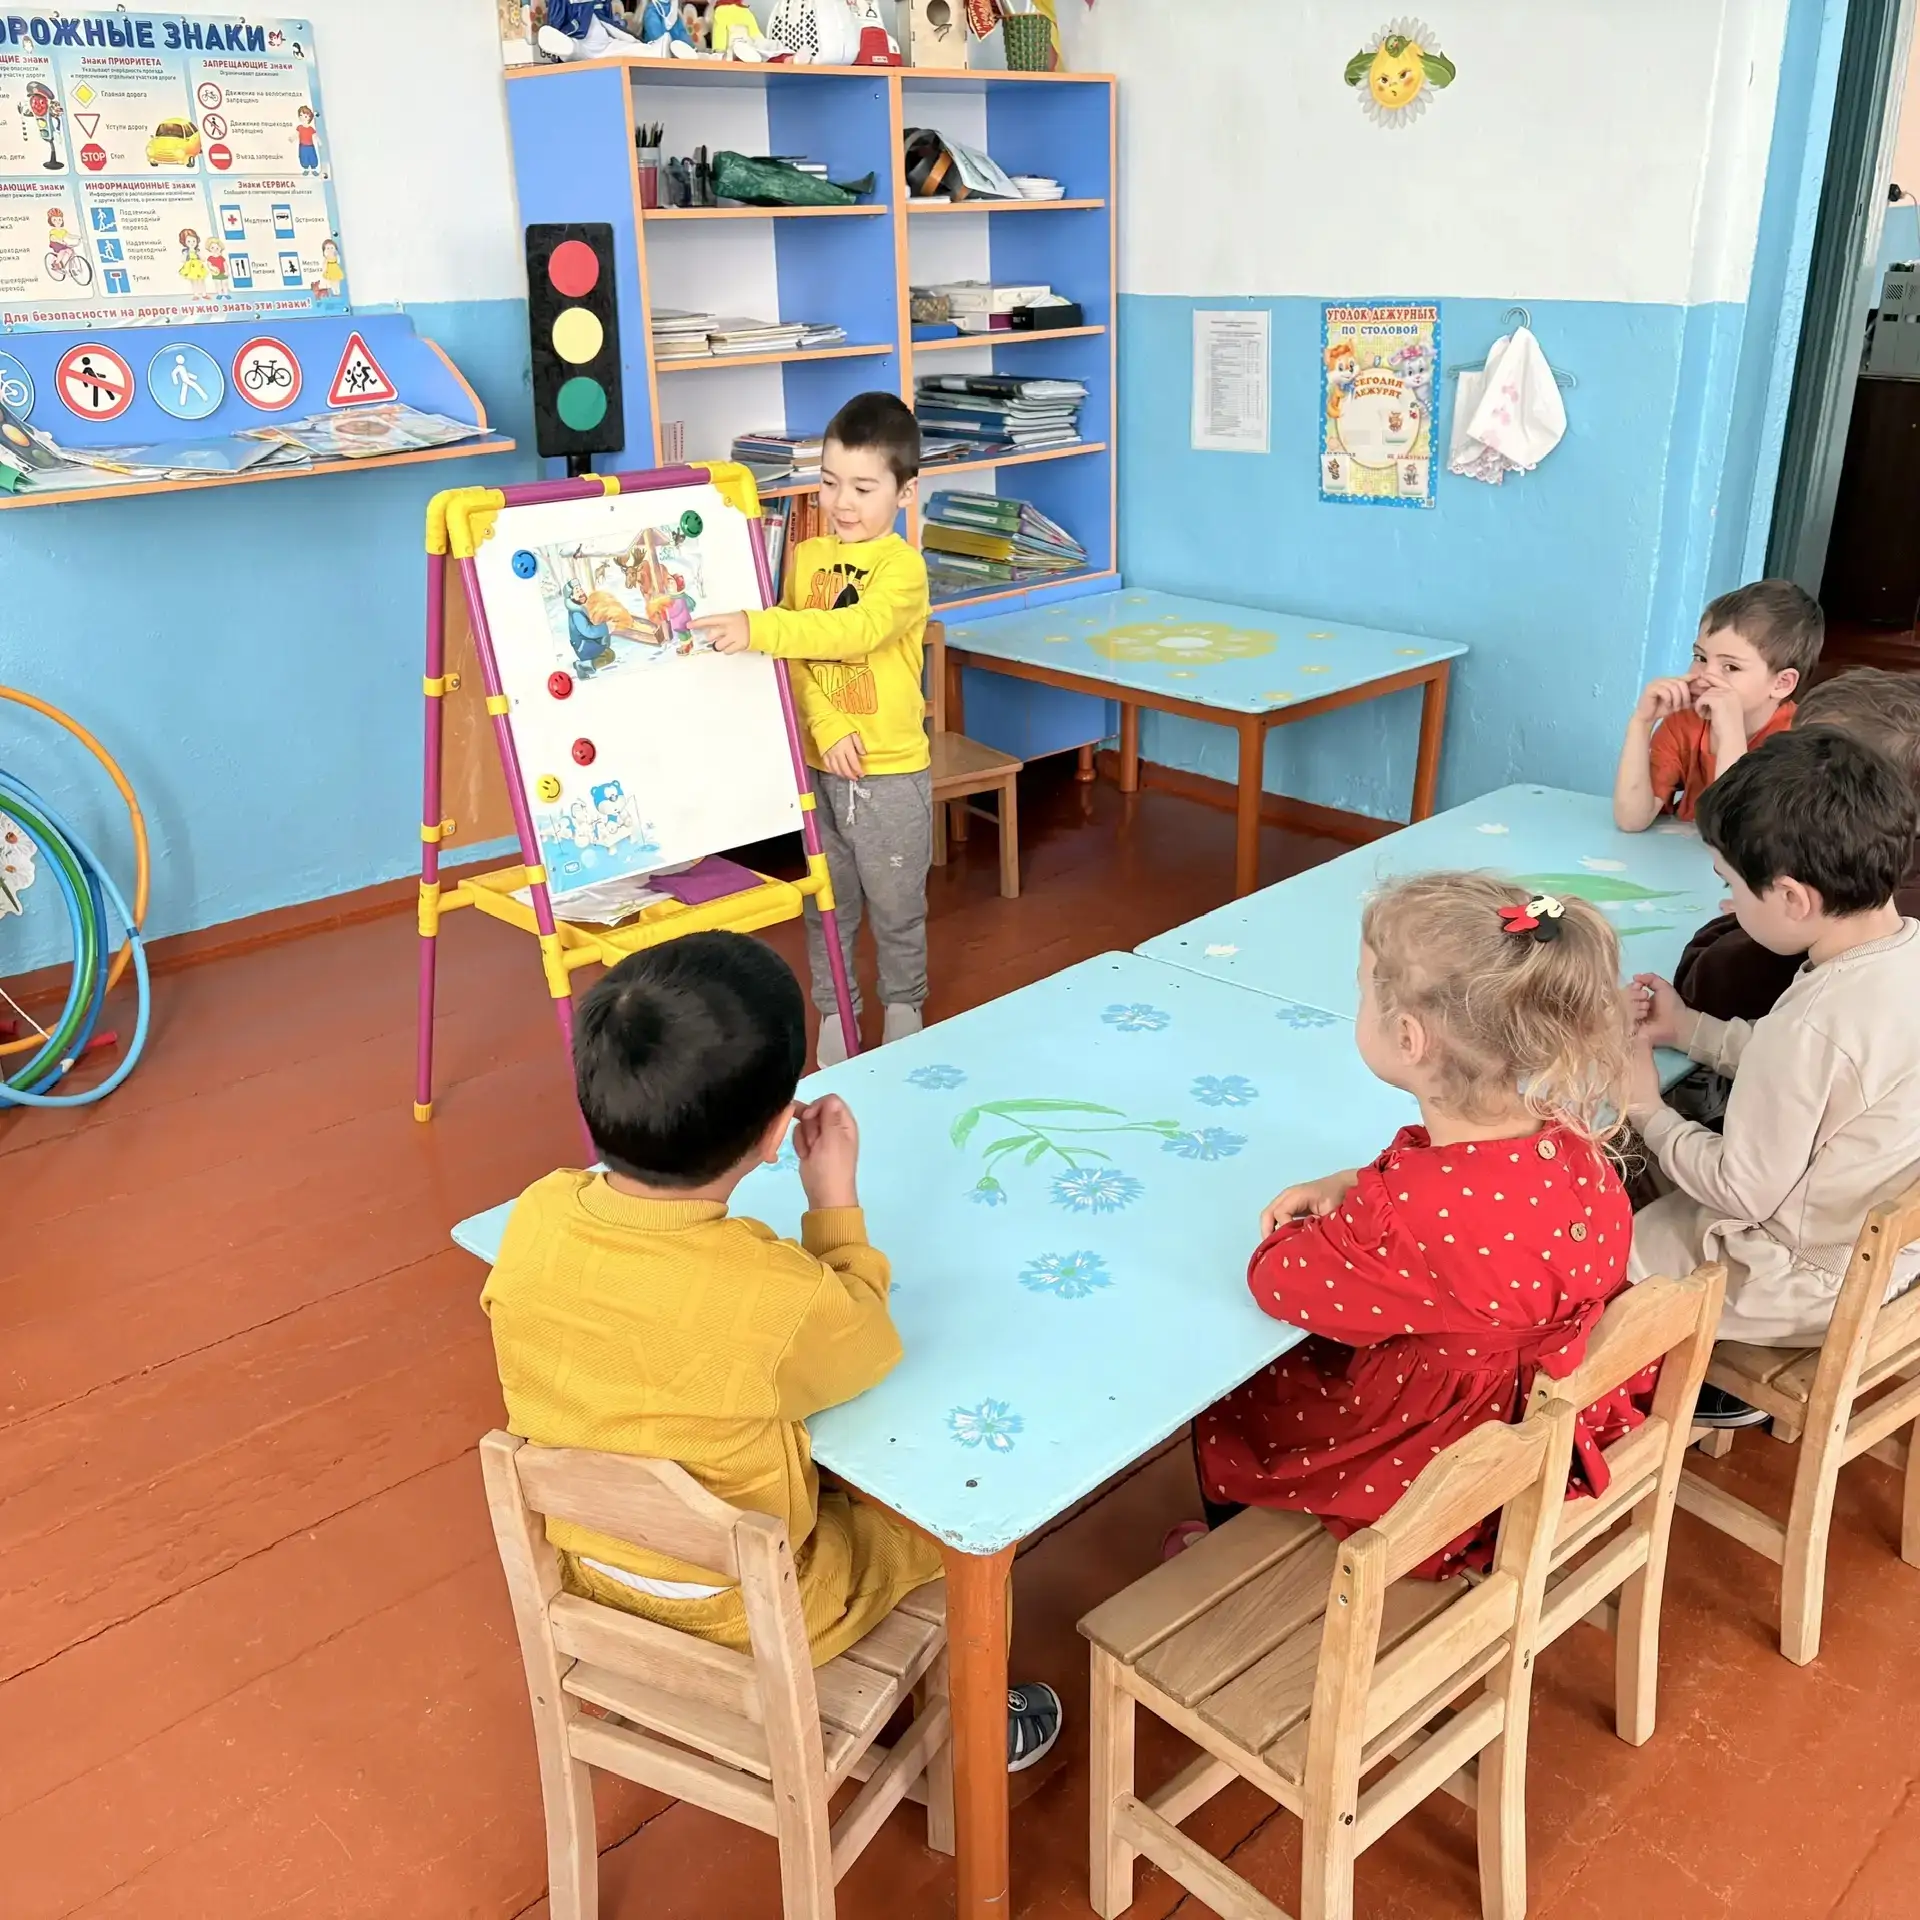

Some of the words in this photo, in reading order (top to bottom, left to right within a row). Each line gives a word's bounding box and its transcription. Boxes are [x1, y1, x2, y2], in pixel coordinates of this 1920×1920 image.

[162, 20, 266, 52] ЗНАКИ
[108, 58, 161, 66] ПРИОРИТЕТА
[203, 60, 268, 69] ЗАПРЕЩАЮЩИЕ
[82, 152, 105, 162] STOP
[85, 182, 170, 190] ИНФОРМАЦИОННЫЕ
[4, 313, 29, 325] Для
[33, 309, 117, 322] безопасности
[121, 308, 134, 317] на
[138, 306, 178, 319] дороге
[182, 304, 218, 316] нужно
[223, 303, 252, 312] знать
[276, 299, 311, 309] знаки!
[1328, 309, 1368, 320] УГОЛОК
[1373, 308, 1435, 320] ДЕЖУРНЫХ
[1360, 325, 1418, 334] СТОЛОВОЙ
[1354, 377, 1403, 388] СЕГОДНЯ
[1354, 388, 1401, 399] ДЕЖУРЯТ
